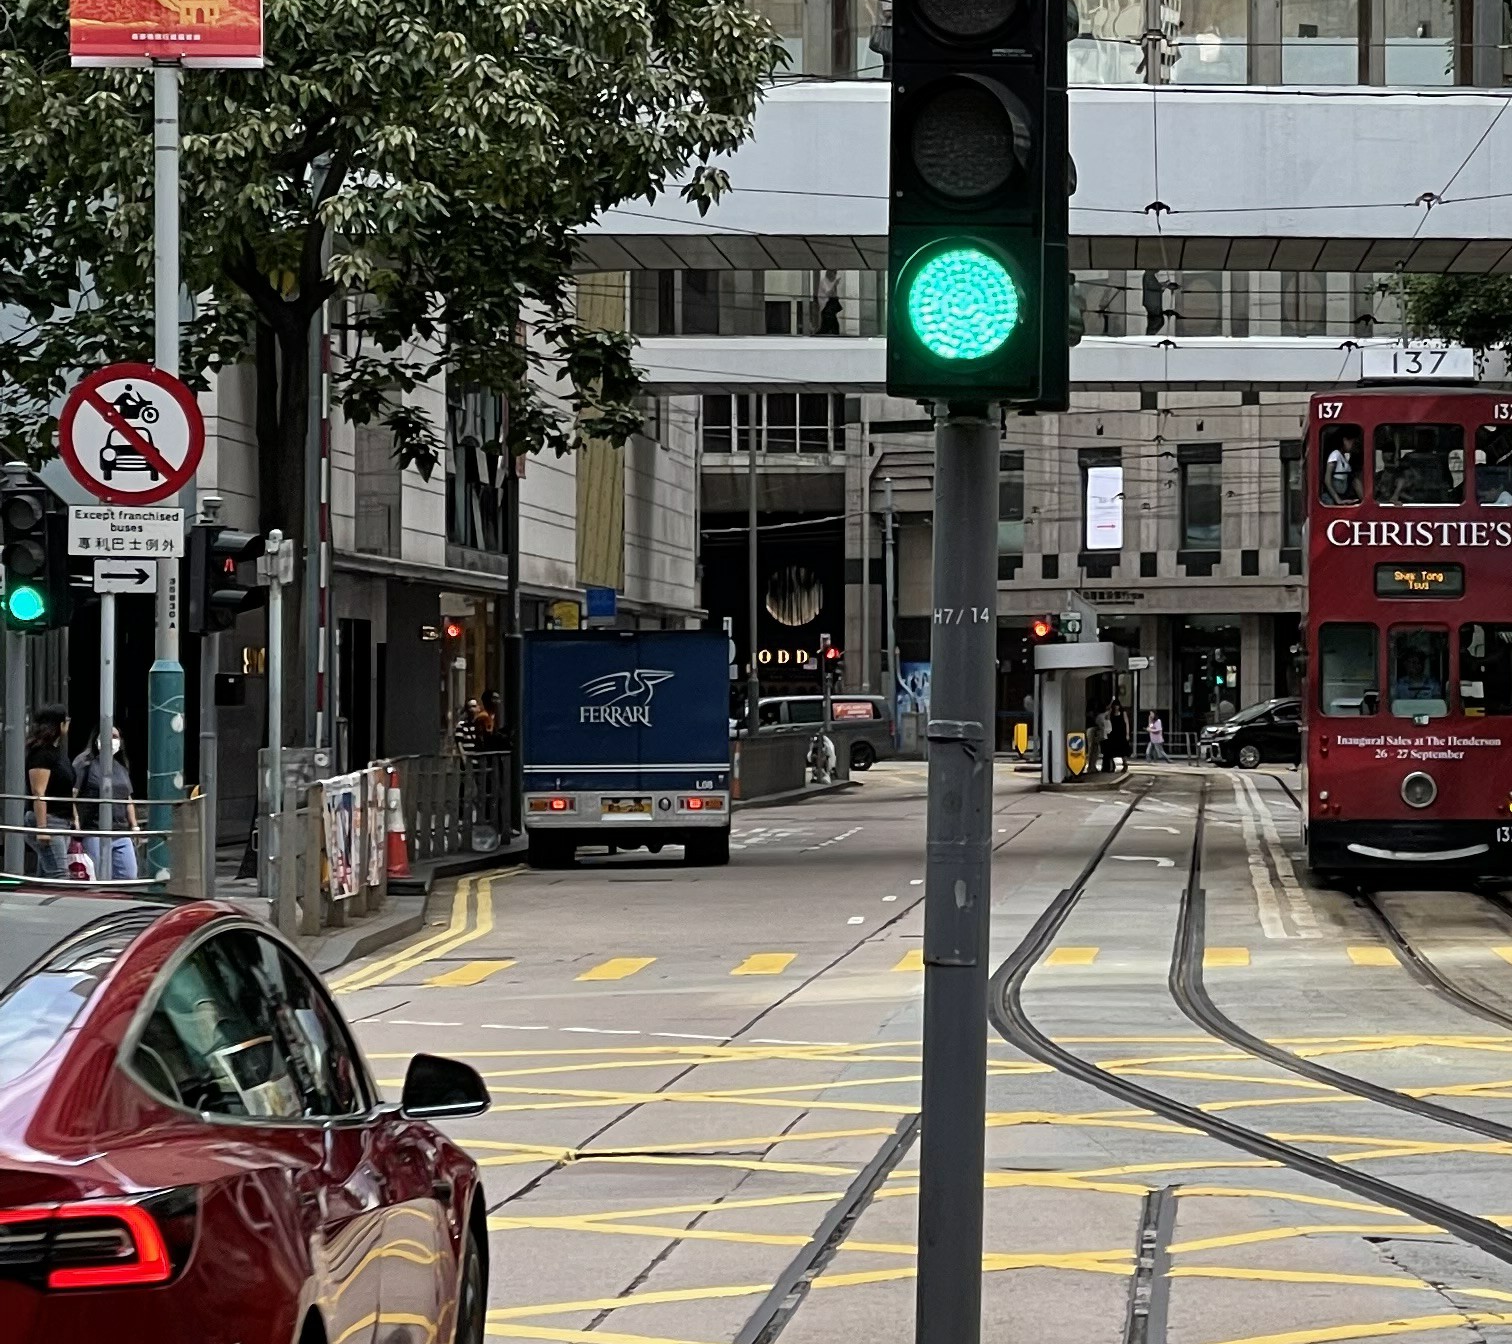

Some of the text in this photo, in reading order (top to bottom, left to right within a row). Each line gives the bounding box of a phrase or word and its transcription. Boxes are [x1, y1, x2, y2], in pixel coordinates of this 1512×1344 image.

[1392, 350, 1448, 375] 137
[1318, 402, 1343, 419] 137
[75, 509, 179, 522] Except franchised
[110, 523, 143, 533] buses
[1326, 519, 1512, 547] CHRISTIE'S
[580, 706, 652, 728] FERRARI
[1337, 735, 1502, 747] Inaugural Sales at The Henderson
[1375, 749, 1388, 759] 26
[1397, 749, 1409, 759] 27
[1410, 749, 1465, 761] September
